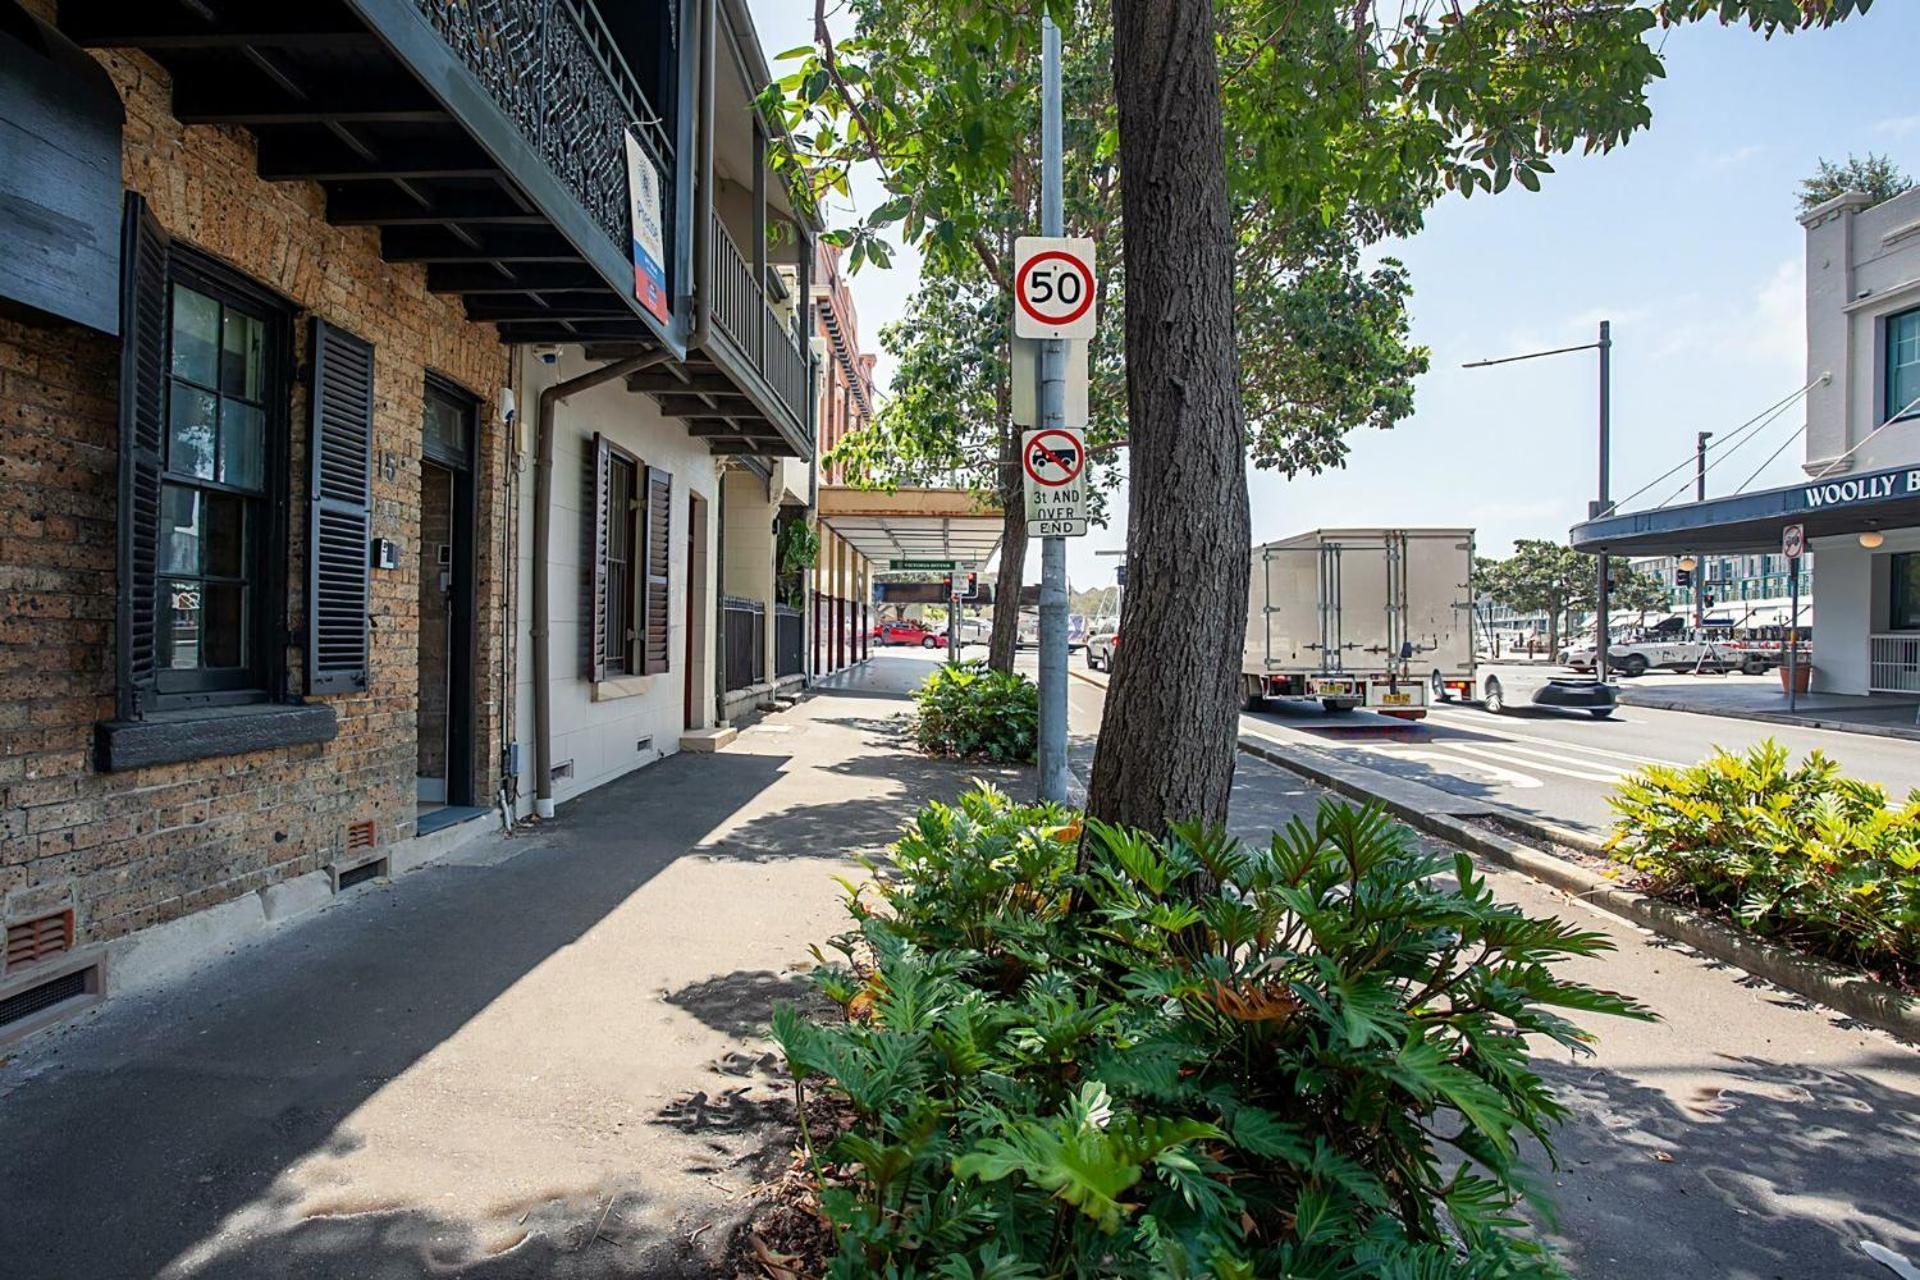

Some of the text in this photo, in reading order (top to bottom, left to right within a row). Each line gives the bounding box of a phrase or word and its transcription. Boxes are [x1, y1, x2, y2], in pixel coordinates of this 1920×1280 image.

[1031, 271, 1080, 304] 50
[1034, 490, 1080, 504] 3t AND
[1805, 474, 1896, 508] WOOLLY
[1037, 507, 1074, 519] OVER
[1040, 522, 1074, 534] END
